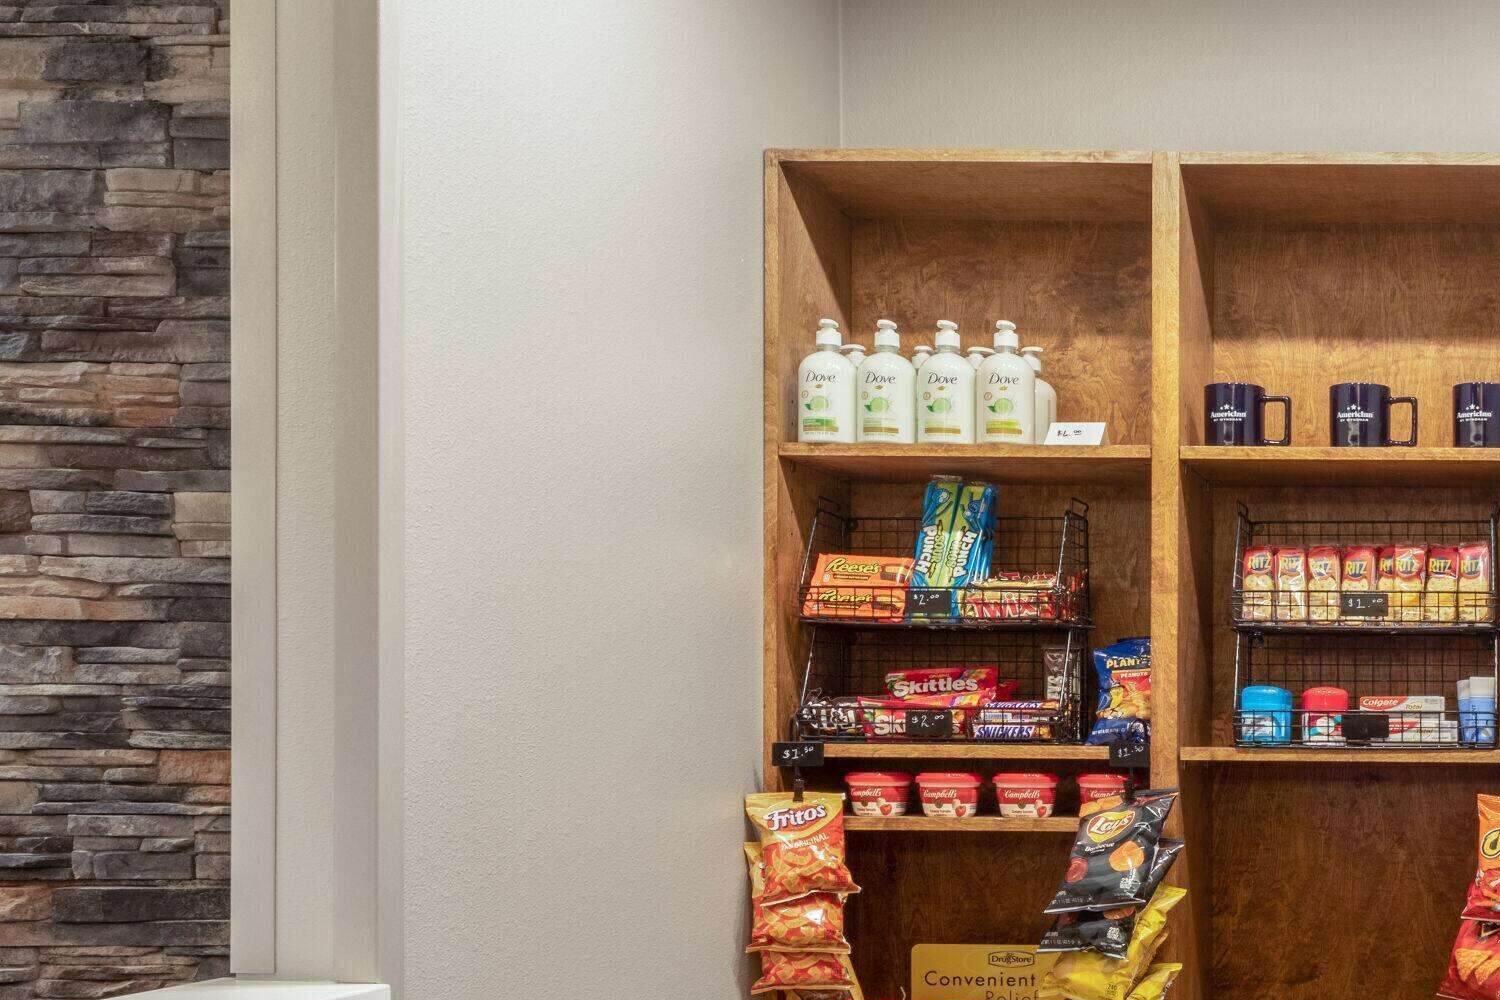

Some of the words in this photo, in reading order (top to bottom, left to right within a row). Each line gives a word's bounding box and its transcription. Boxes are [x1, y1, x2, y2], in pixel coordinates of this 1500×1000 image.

[805, 370, 836, 383] Dove
[865, 371, 896, 384] Dove
[928, 371, 958, 385] Dove
[988, 372, 1020, 385] Dove
[1337, 411, 1373, 419] AmericInn
[915, 525, 937, 574] PUNCH
[952, 531, 977, 578] PUNCH
[824, 557, 880, 573] Reese's
[1248, 553, 1271, 570] RITZ
[1345, 560, 1368, 574] RITZ
[1429, 559, 1452, 572] RITZ
[913, 594, 940, 606] $2.00
[893, 678, 978, 698] Skittles
[1362, 698, 1399, 707] Colgate
[976, 725, 1035, 739] SNICKERS
[851, 787, 882, 798] Campbell's
[923, 788, 957, 799] Campbell's
[1004, 789, 1040, 799] Campbell's
[763, 805, 827, 831] Fritos
[1090, 816, 1130, 834] Lay's
[990, 955, 1033, 963] DrugStore
[924, 970, 1036, 987] Convenient
